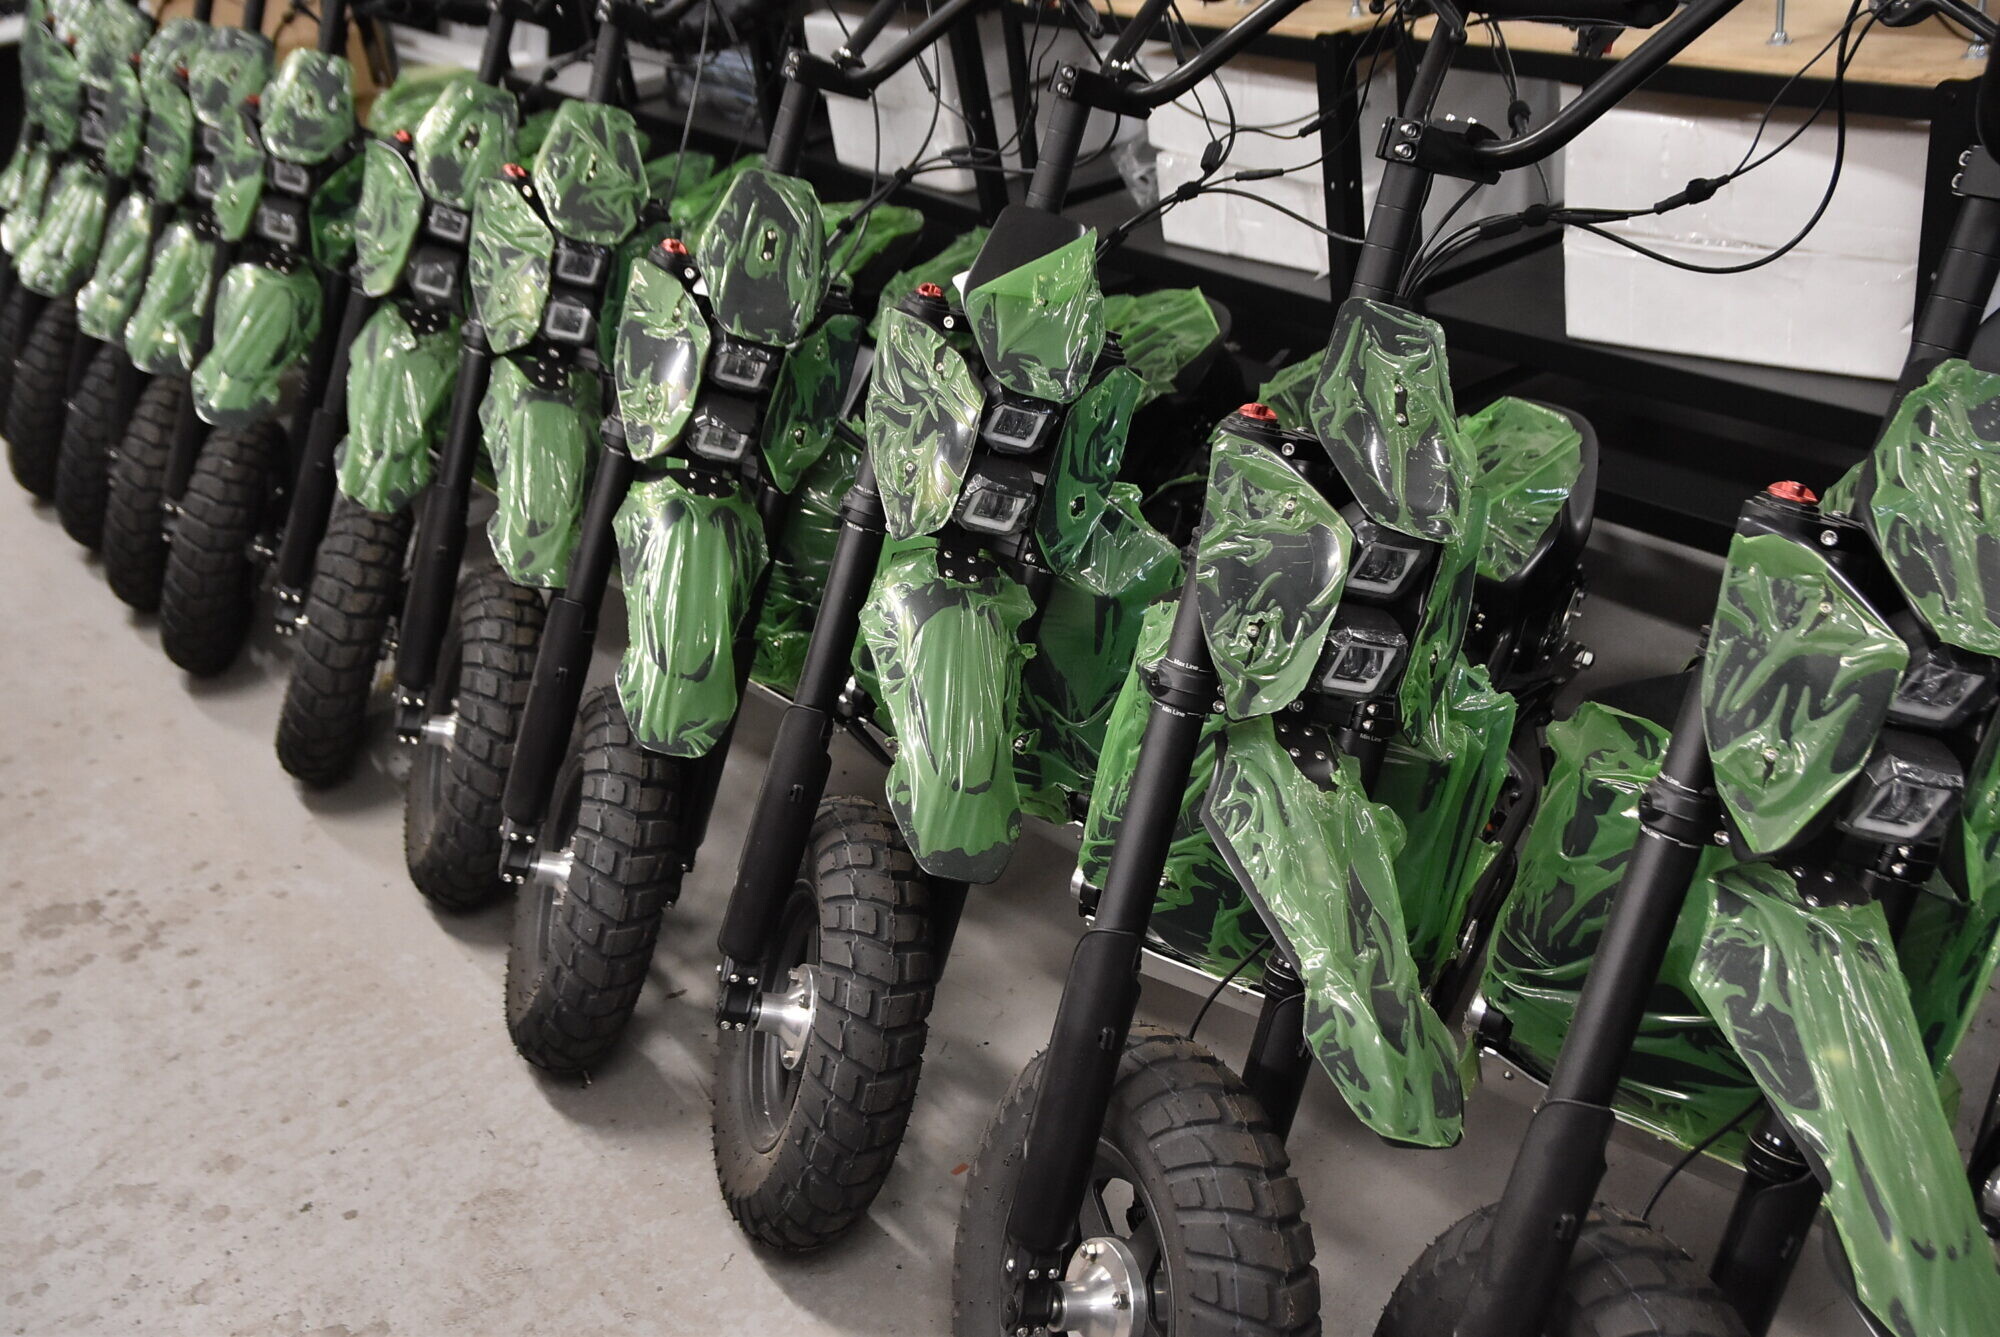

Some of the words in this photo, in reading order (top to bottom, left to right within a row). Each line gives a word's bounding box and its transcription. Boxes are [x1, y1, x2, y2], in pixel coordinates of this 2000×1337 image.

[1173, 658, 1185, 667] Max
[1185, 662, 1199, 671] Line
[1162, 705, 1172, 713] Min
[1172, 709, 1186, 717] Line
